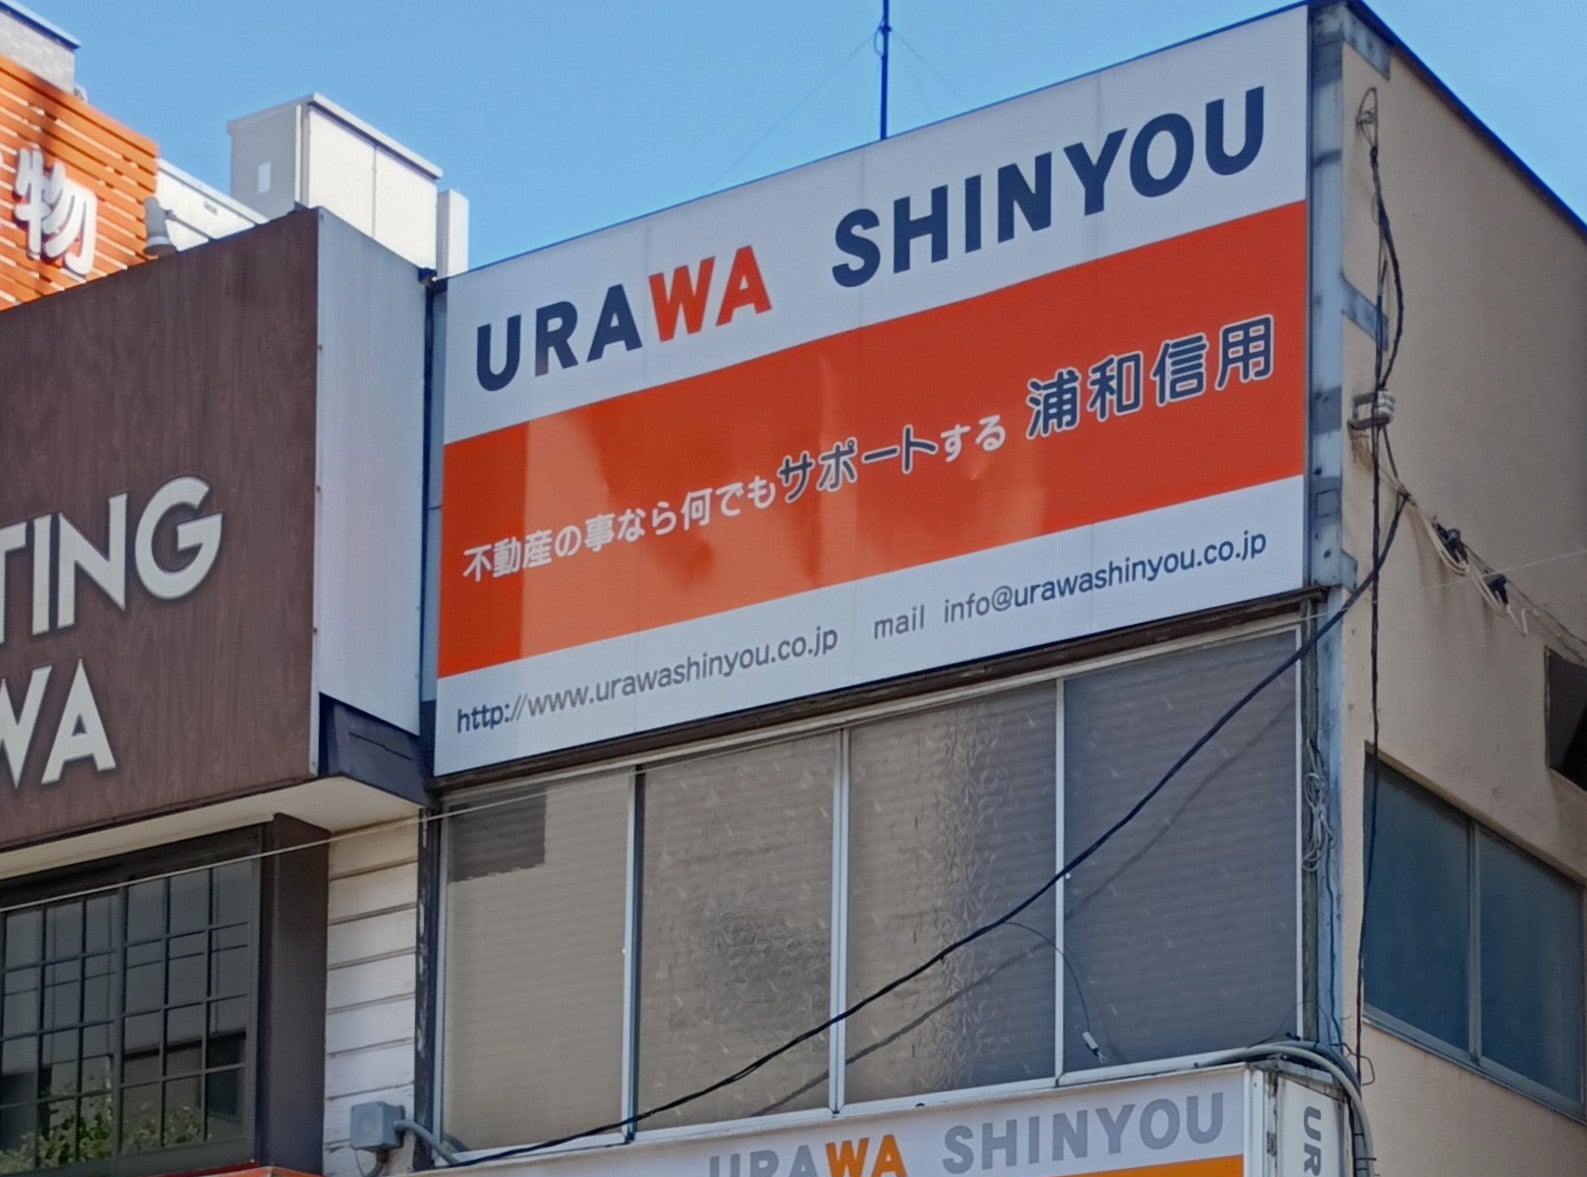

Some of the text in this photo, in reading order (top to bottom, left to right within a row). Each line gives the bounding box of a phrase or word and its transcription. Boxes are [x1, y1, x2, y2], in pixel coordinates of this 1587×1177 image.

[14, 148, 98, 276] 物
[475, 86, 1265, 393] URAWA SHINYOU
[462, 314, 1275, 583] 不動産の事なら何でもサポートする 浦和信用
[456, 530, 1267, 734] http://www.urawashinyou.co.jp mail info@urawashinyou.co.jp
[941, 1092, 1225, 1176] SHINYOU
